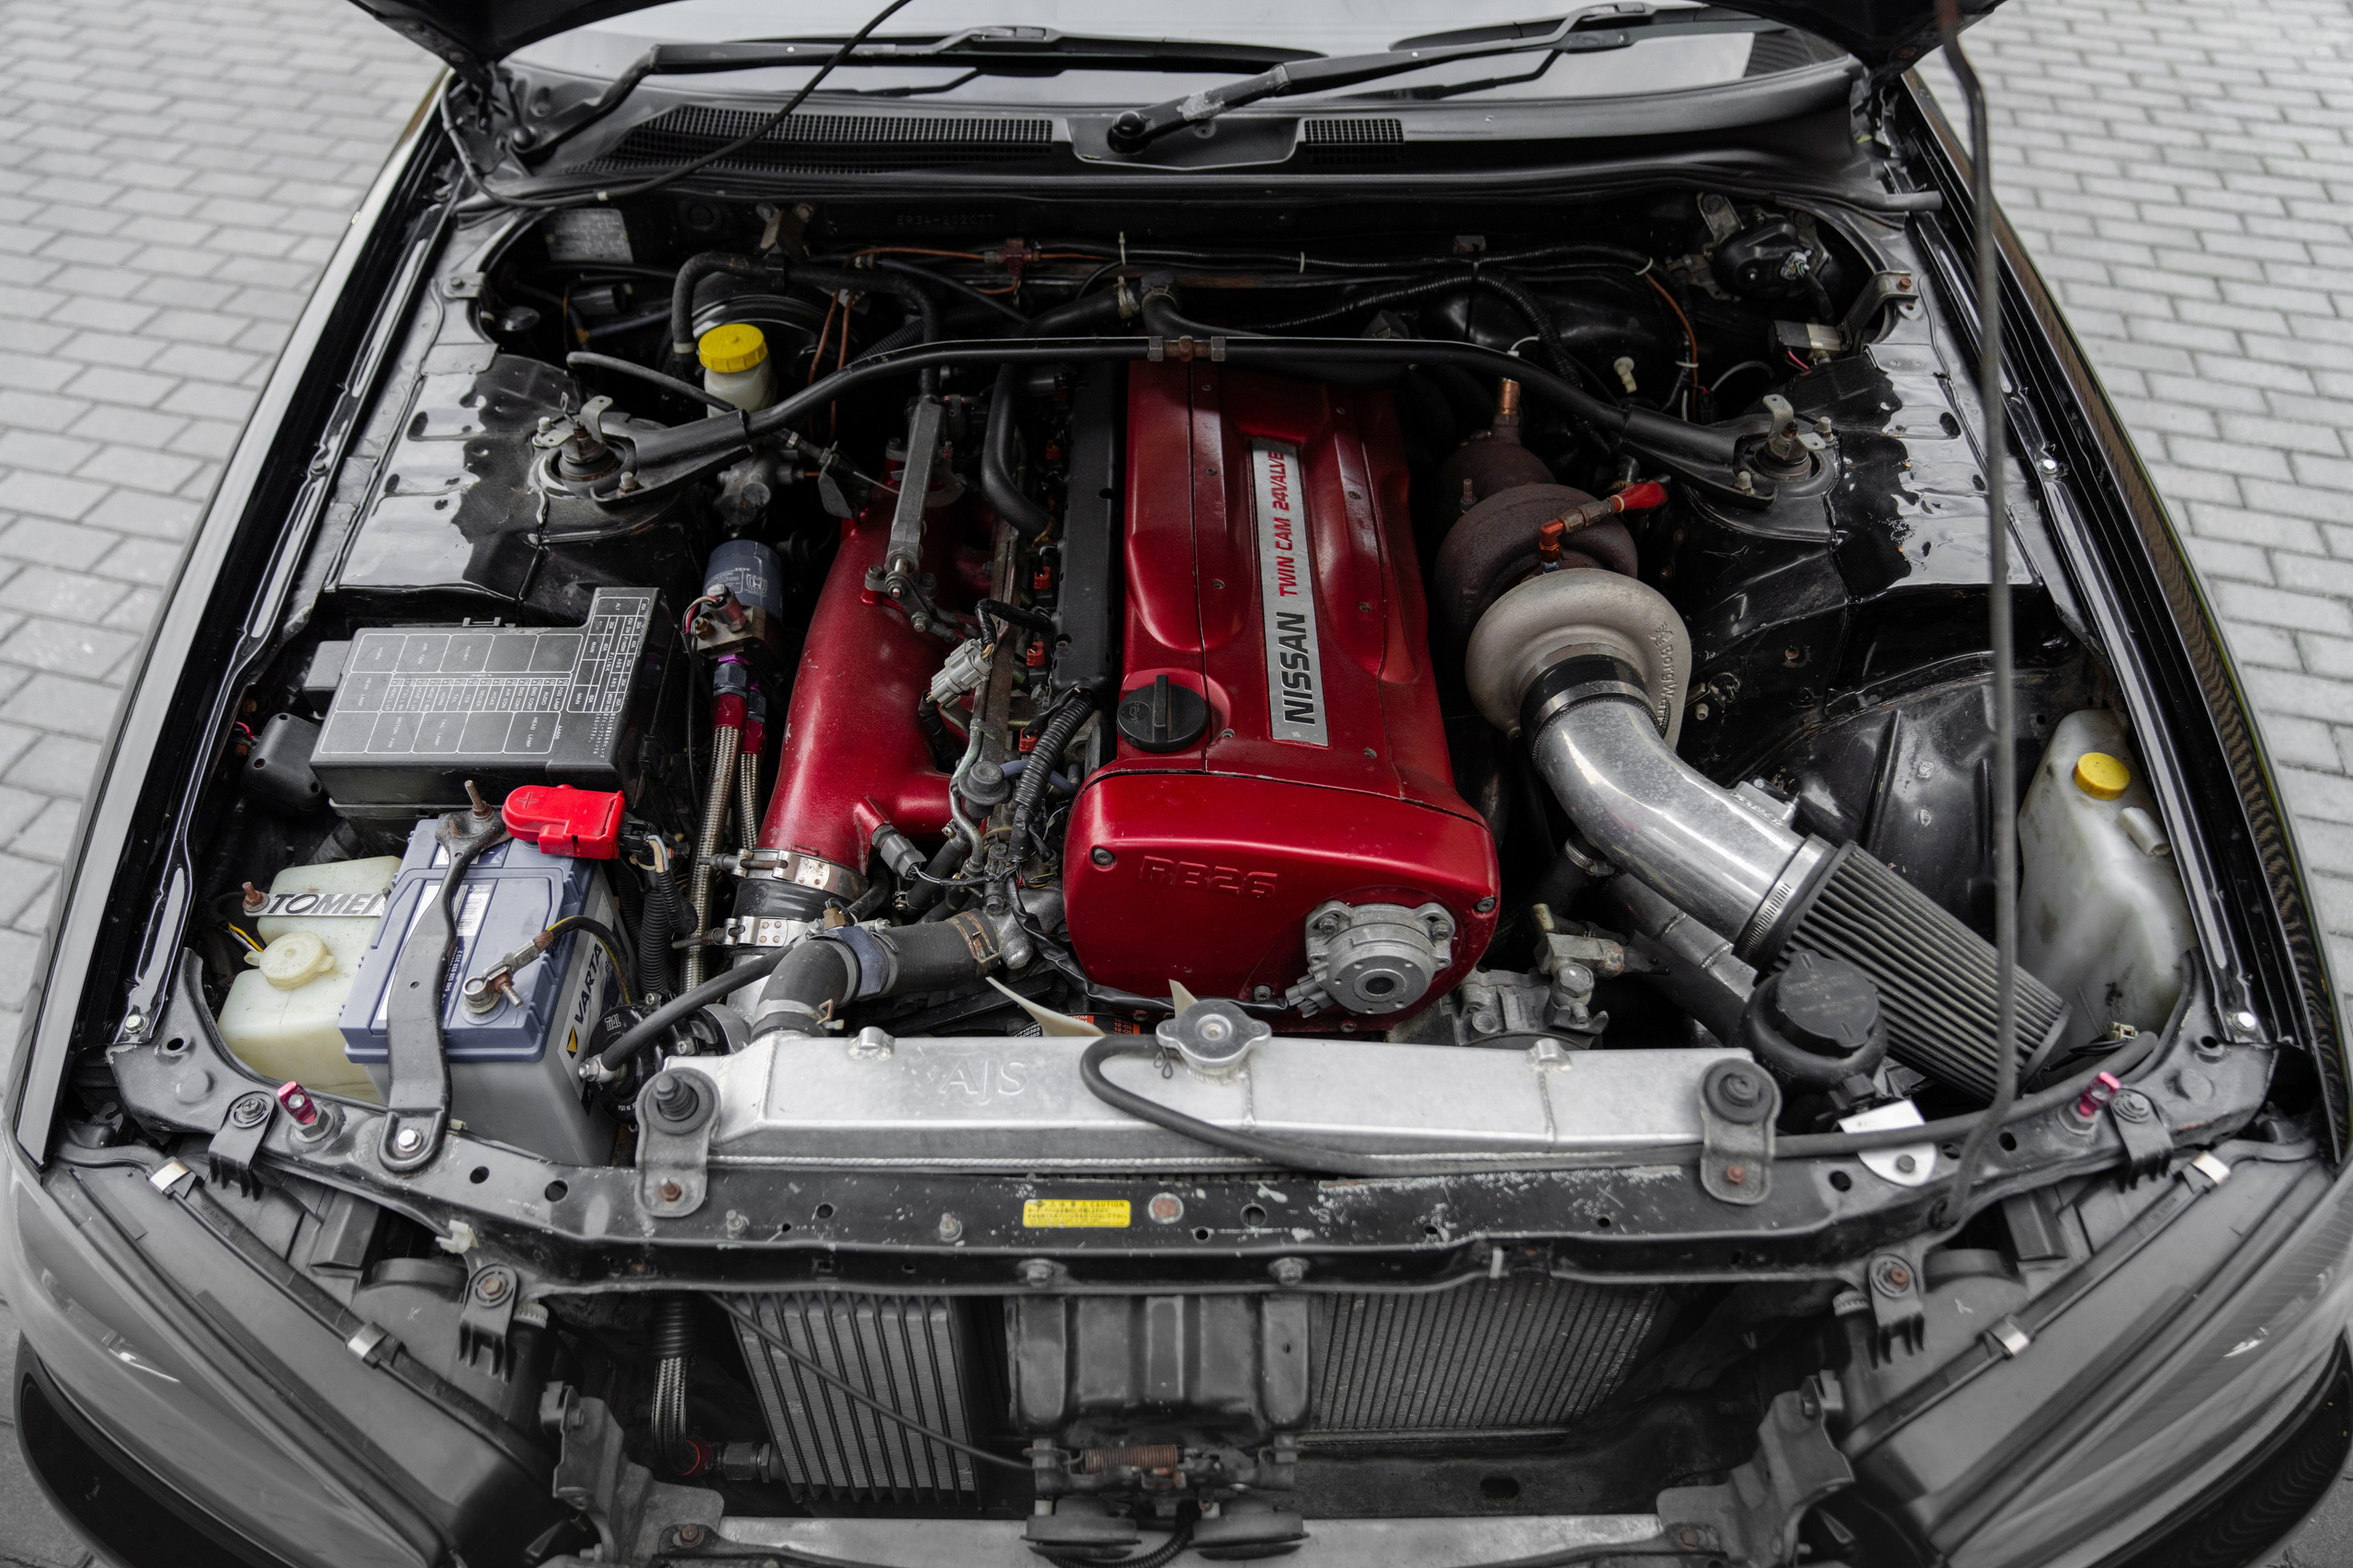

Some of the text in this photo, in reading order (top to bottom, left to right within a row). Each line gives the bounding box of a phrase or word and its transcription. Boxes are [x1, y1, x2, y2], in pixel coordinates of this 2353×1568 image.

[1267, 450, 1315, 725] NISSAN TWIN CAM 24VALVE
[364, 677, 372, 690] HEAD
[438, 692, 446, 705] HORN
[392, 717, 402, 733] MOTOR
[435, 733, 443, 745] LAMP
[526, 734, 534, 747] LAMP
[1139, 855, 1278, 899] RB26
[267, 893, 384, 915] TOMEI
[574, 942, 603, 1025] VARTA
[938, 1058, 1028, 1106] AJS
